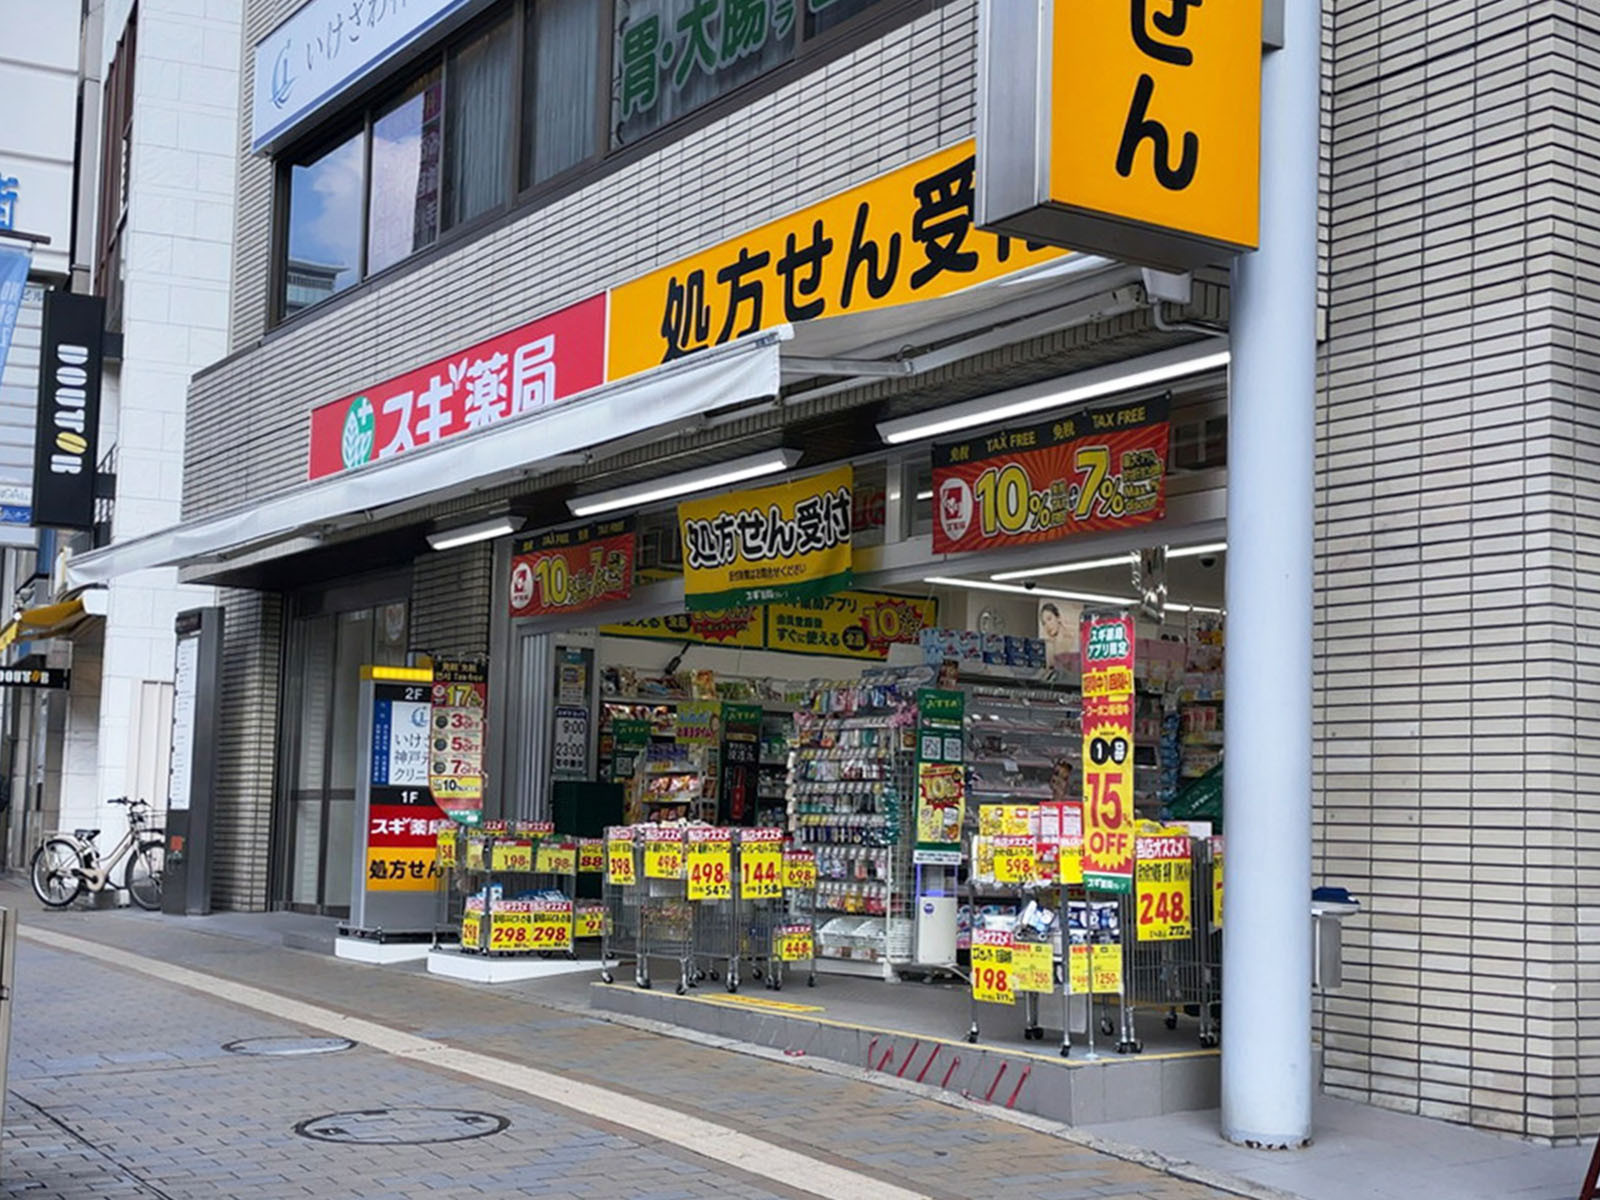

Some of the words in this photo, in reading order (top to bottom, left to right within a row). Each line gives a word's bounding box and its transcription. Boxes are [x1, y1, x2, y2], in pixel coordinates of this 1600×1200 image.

[661, 155, 1050, 365] 処方せん受
[379, 333, 556, 459] スギ薬局
[51, 344, 88, 474] DOUTOR
[986, 434, 1008, 452] TAX
[1010, 432, 1037, 448] FREE
[1092, 412, 1115, 428] TAX
[1117, 407, 1147, 425] FREE
[687, 488, 850, 568] 処方せん受付
[404, 686, 423, 701] 2F
[400, 790, 419, 804] 1F
[1089, 832, 1128, 854] OFF
[691, 862, 724, 884] 498
[744, 861, 775, 884] 144
[1005, 858, 1031, 873] 598
[705, 885, 727, 896] 547
[1140, 891, 1184, 925] 248
[493, 927, 526, 942] 298
[533, 926, 567, 942] 298
[974, 967, 1007, 991] 198
